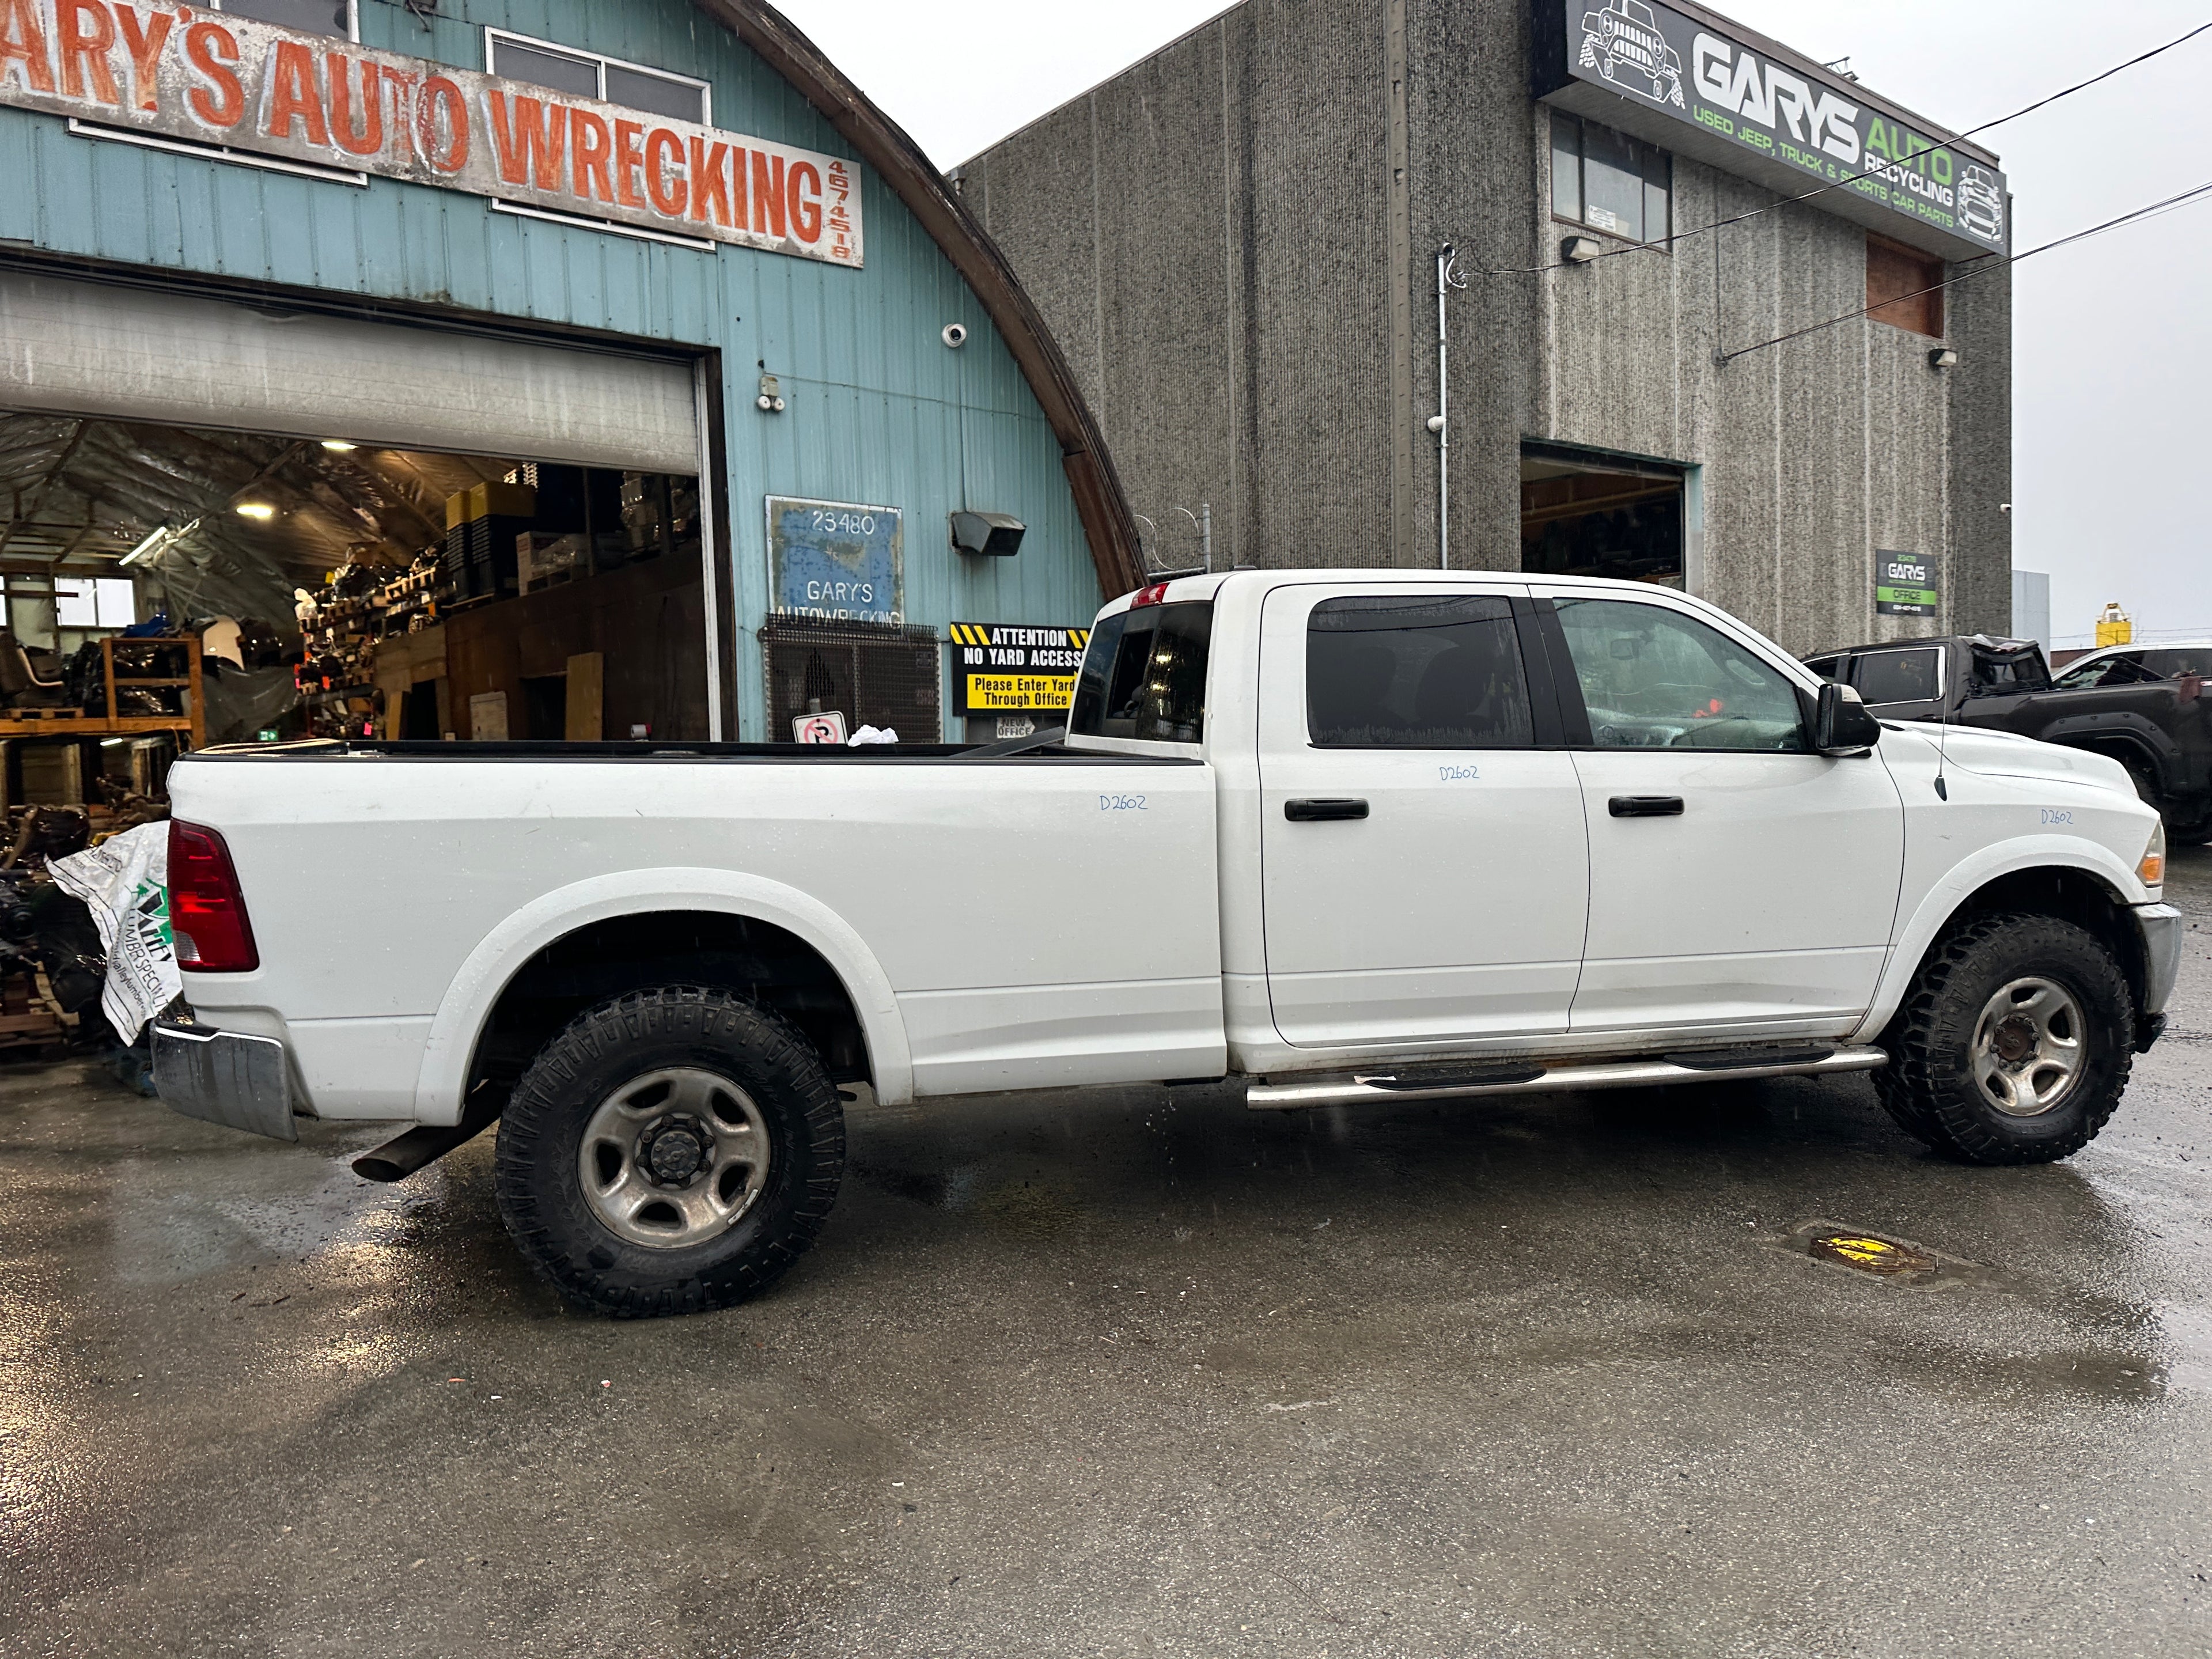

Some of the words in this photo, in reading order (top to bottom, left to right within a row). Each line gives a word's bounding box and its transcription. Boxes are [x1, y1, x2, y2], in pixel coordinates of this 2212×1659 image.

[1692, 32, 1859, 164] GARYS
[1865, 117, 1953, 185] AUTO
[270, 40, 469, 172] AUTO
[487, 89, 822, 244] WRECKING
[1694, 104, 1734, 135] USED
[1737, 126, 1775, 156] JEEP,
[1779, 142, 1823, 173] TRUCK
[1827, 164, 1836, 179] &
[1840, 169, 1888, 200] SPORTS
[1891, 191, 1915, 213] CAR
[1918, 203, 1953, 228] PARTS
[1865, 151, 1953, 207] RECYCLING
[812, 510, 874, 535] 23480
[1888, 563, 1925, 581] GARYS
[807, 581, 873, 603] GARY'S
[1894, 589, 1921, 600] OFFICE
[992, 627, 1067, 647] ATTENTION
[964, 647, 983, 665] NO
[989, 649, 1024, 666] YARD
[1030, 650, 1085, 667] ACCESS
[975, 677, 1012, 691] Please
[1017, 678, 1047, 691] Enter
[1052, 679, 1075, 692] Yard
[984, 692, 1029, 707] Through
[1035, 693, 1067, 705] Office
[998, 727, 1031, 736] OFFICE
[1001, 718, 1025, 727] NEW
[1439, 766, 1480, 781] D2602
[1099, 794, 1148, 810] D2602
[2041, 808, 2074, 824] D2602
